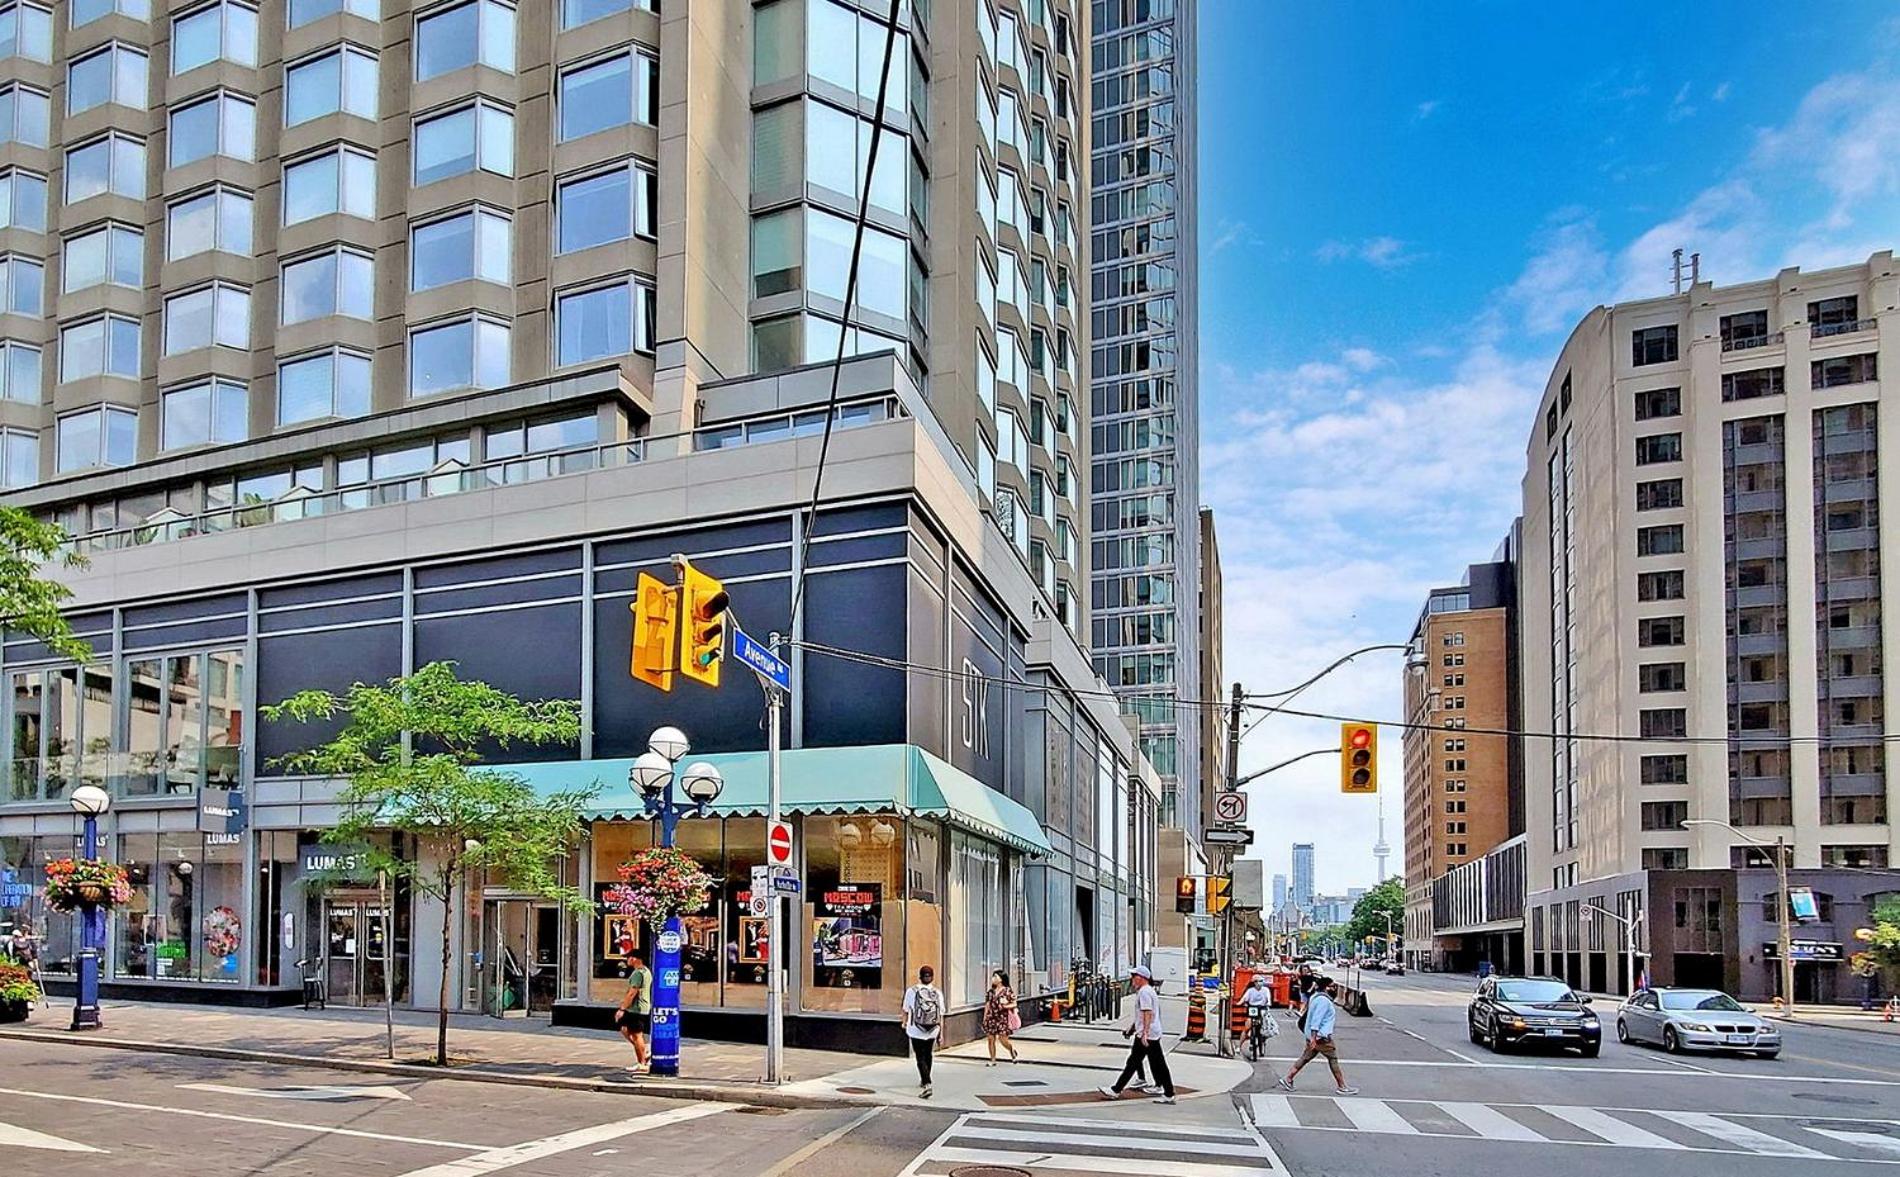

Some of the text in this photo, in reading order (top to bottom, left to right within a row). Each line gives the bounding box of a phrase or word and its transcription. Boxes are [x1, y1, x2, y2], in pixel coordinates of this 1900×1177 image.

[744, 640, 776, 676] Avenue
[962, 656, 989, 760] STK
[207, 833, 240, 845] LUMAS
[306, 855, 356, 870] LUMAS
[823, 891, 873, 903] MOSCOW
[653, 1007, 679, 1016] LET'S
[653, 1015, 668, 1024] GO
